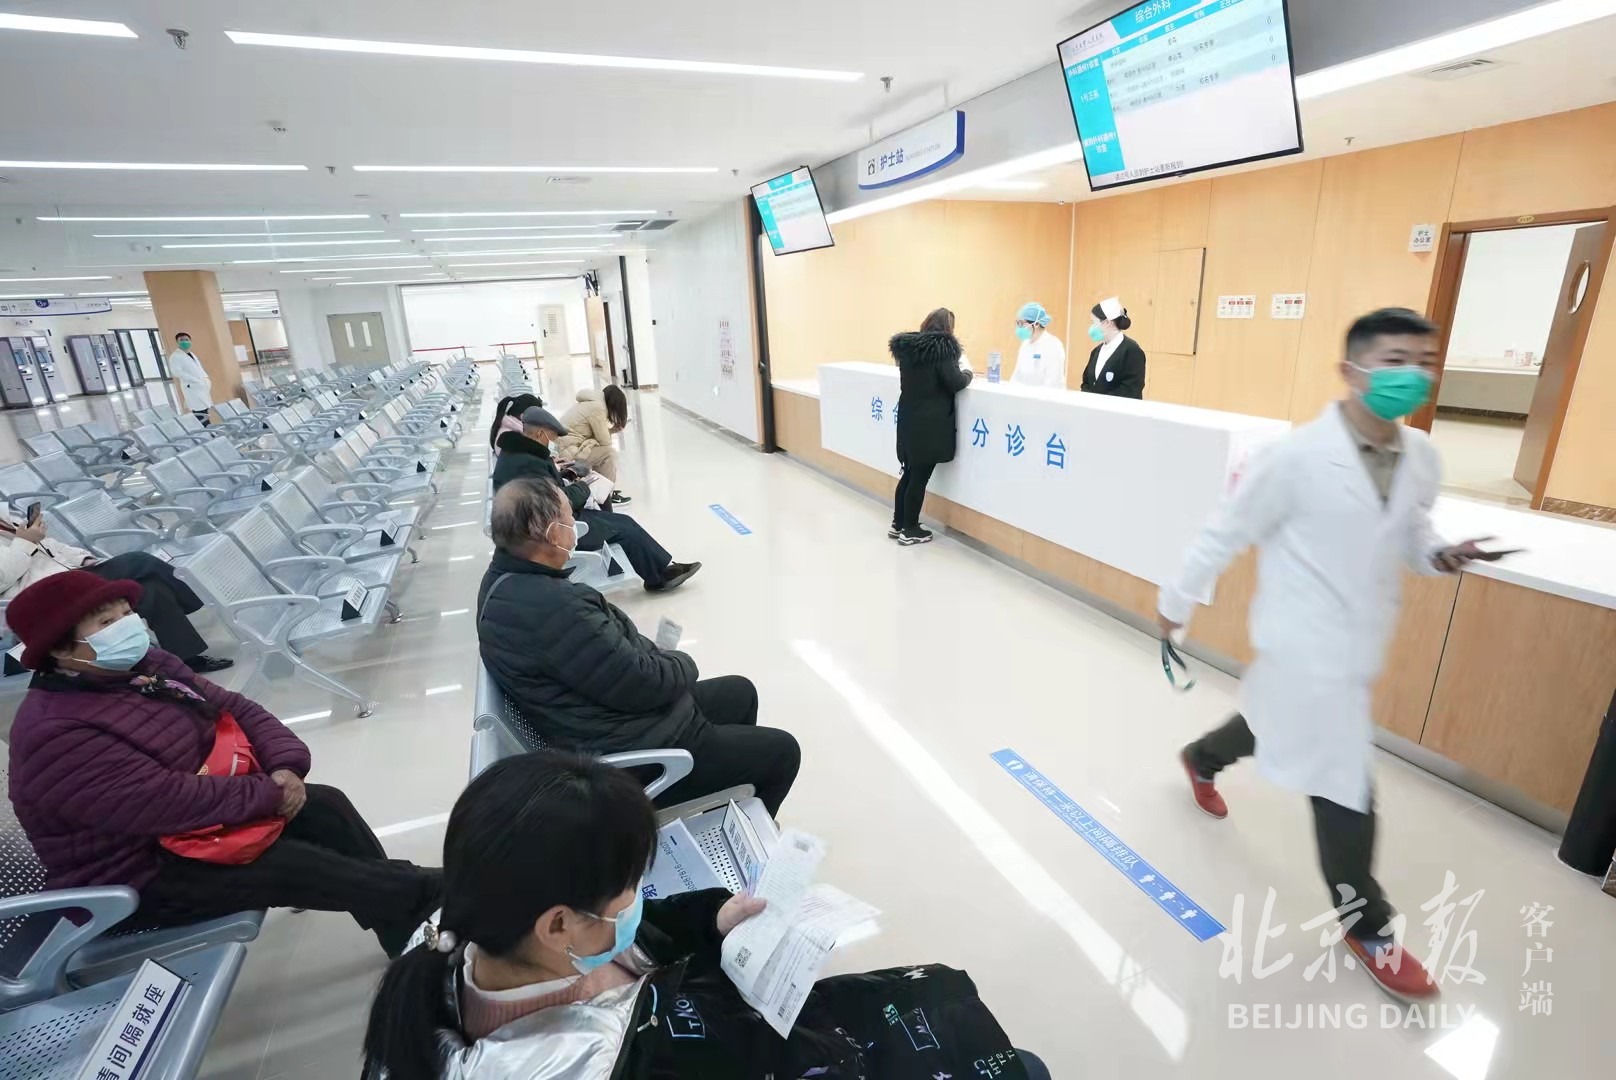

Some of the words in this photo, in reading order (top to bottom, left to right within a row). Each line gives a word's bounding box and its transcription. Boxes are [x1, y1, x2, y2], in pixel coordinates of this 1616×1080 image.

[1135, 0, 1172, 23] 综合外科
[880, 147, 904, 171] 护士站
[1023, 770, 1139, 869] 请保持一米以上间隔排队
